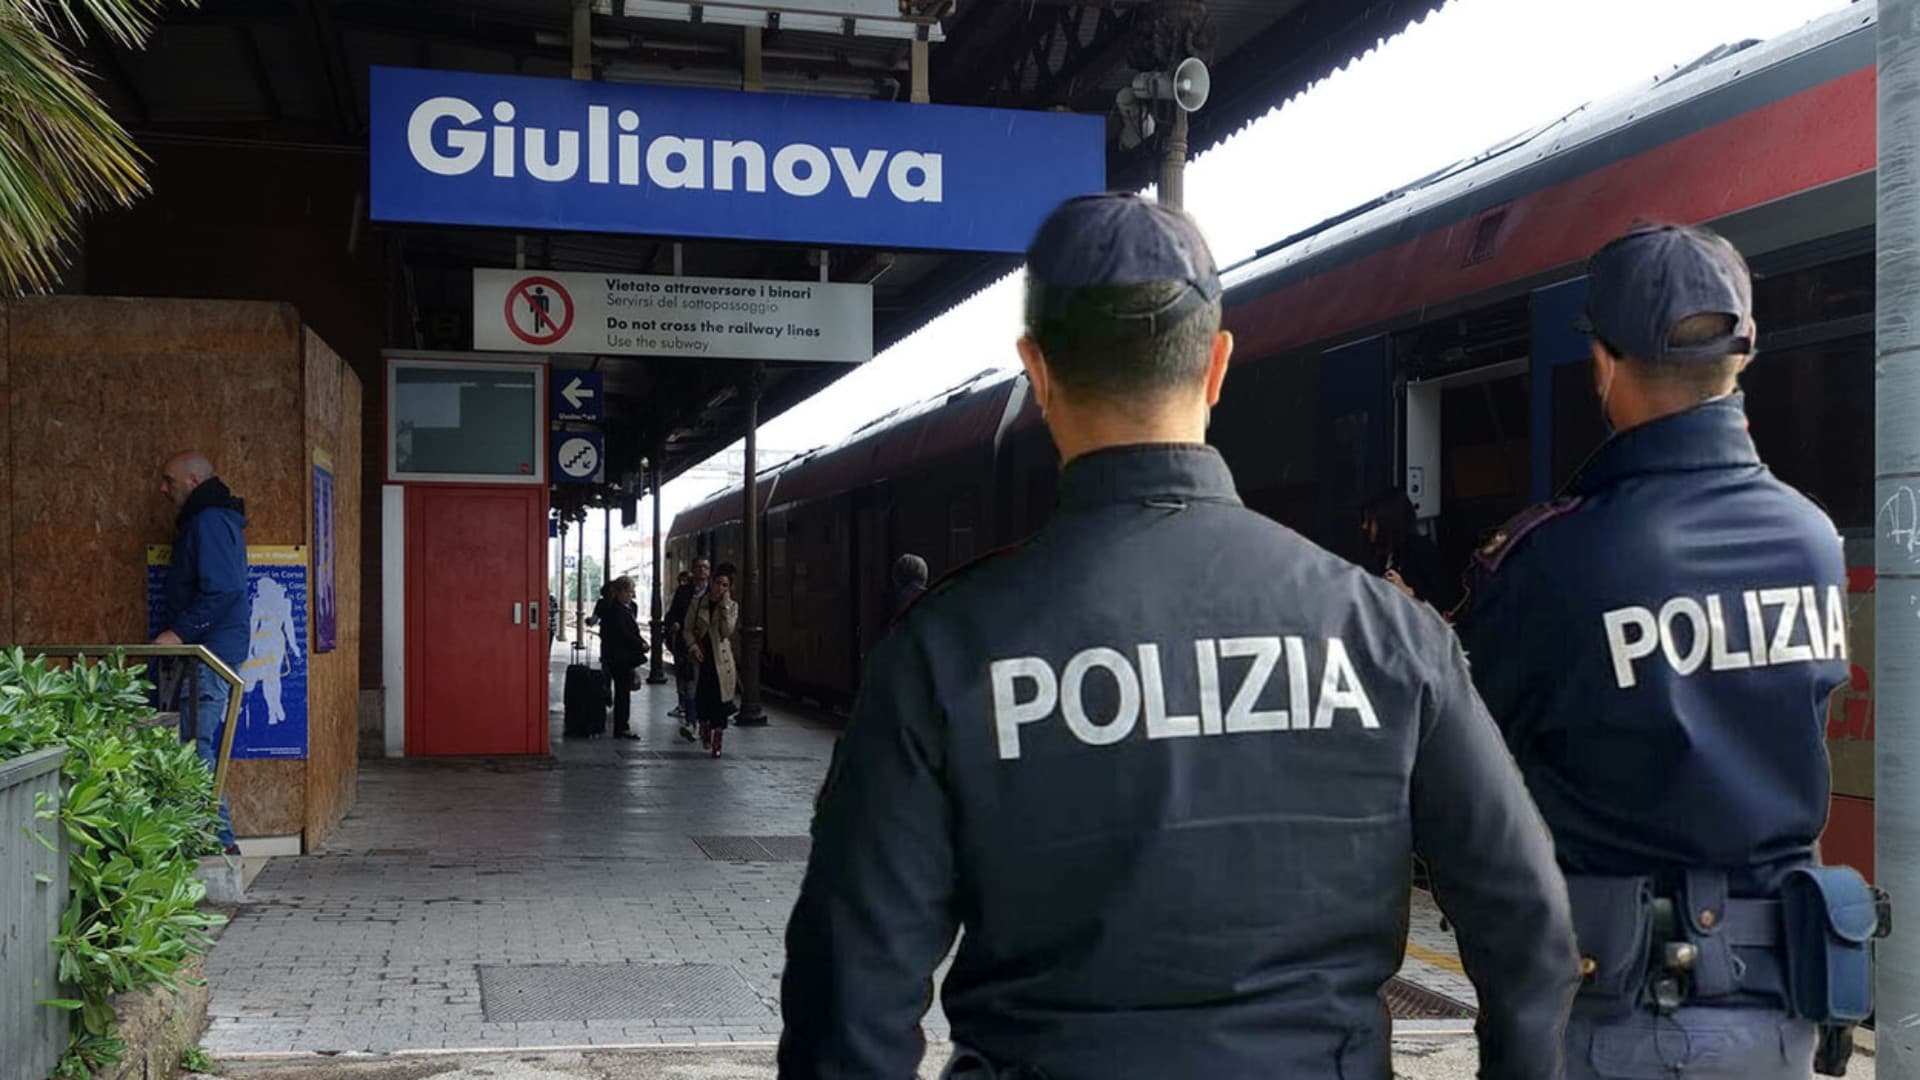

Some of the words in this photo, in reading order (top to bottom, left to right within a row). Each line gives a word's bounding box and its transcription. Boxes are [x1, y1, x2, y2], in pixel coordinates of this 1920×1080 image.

[407, 96, 943, 203] Giulianova
[606, 279, 660, 293] Vietato
[664, 283, 757, 297] attraversare
[760, 285, 765, 297] i
[768, 285, 812, 299] binari
[607, 292, 653, 307] Servirsi
[657, 295, 678, 308] del
[682, 298, 779, 314] sottopassaggio
[607, 317, 628, 330] Do
[632, 320, 656, 331] not
[660, 321, 697, 332] cross
[701, 320, 725, 334] the
[728, 322, 783, 338] railway
[787, 323, 821, 337] lines
[607, 334, 632, 347] Use
[636, 334, 657, 348] the
[660, 335, 710, 353] subway
[1603, 585, 1847, 688] POLIZIA
[991, 635, 1381, 760] POLIZIA
